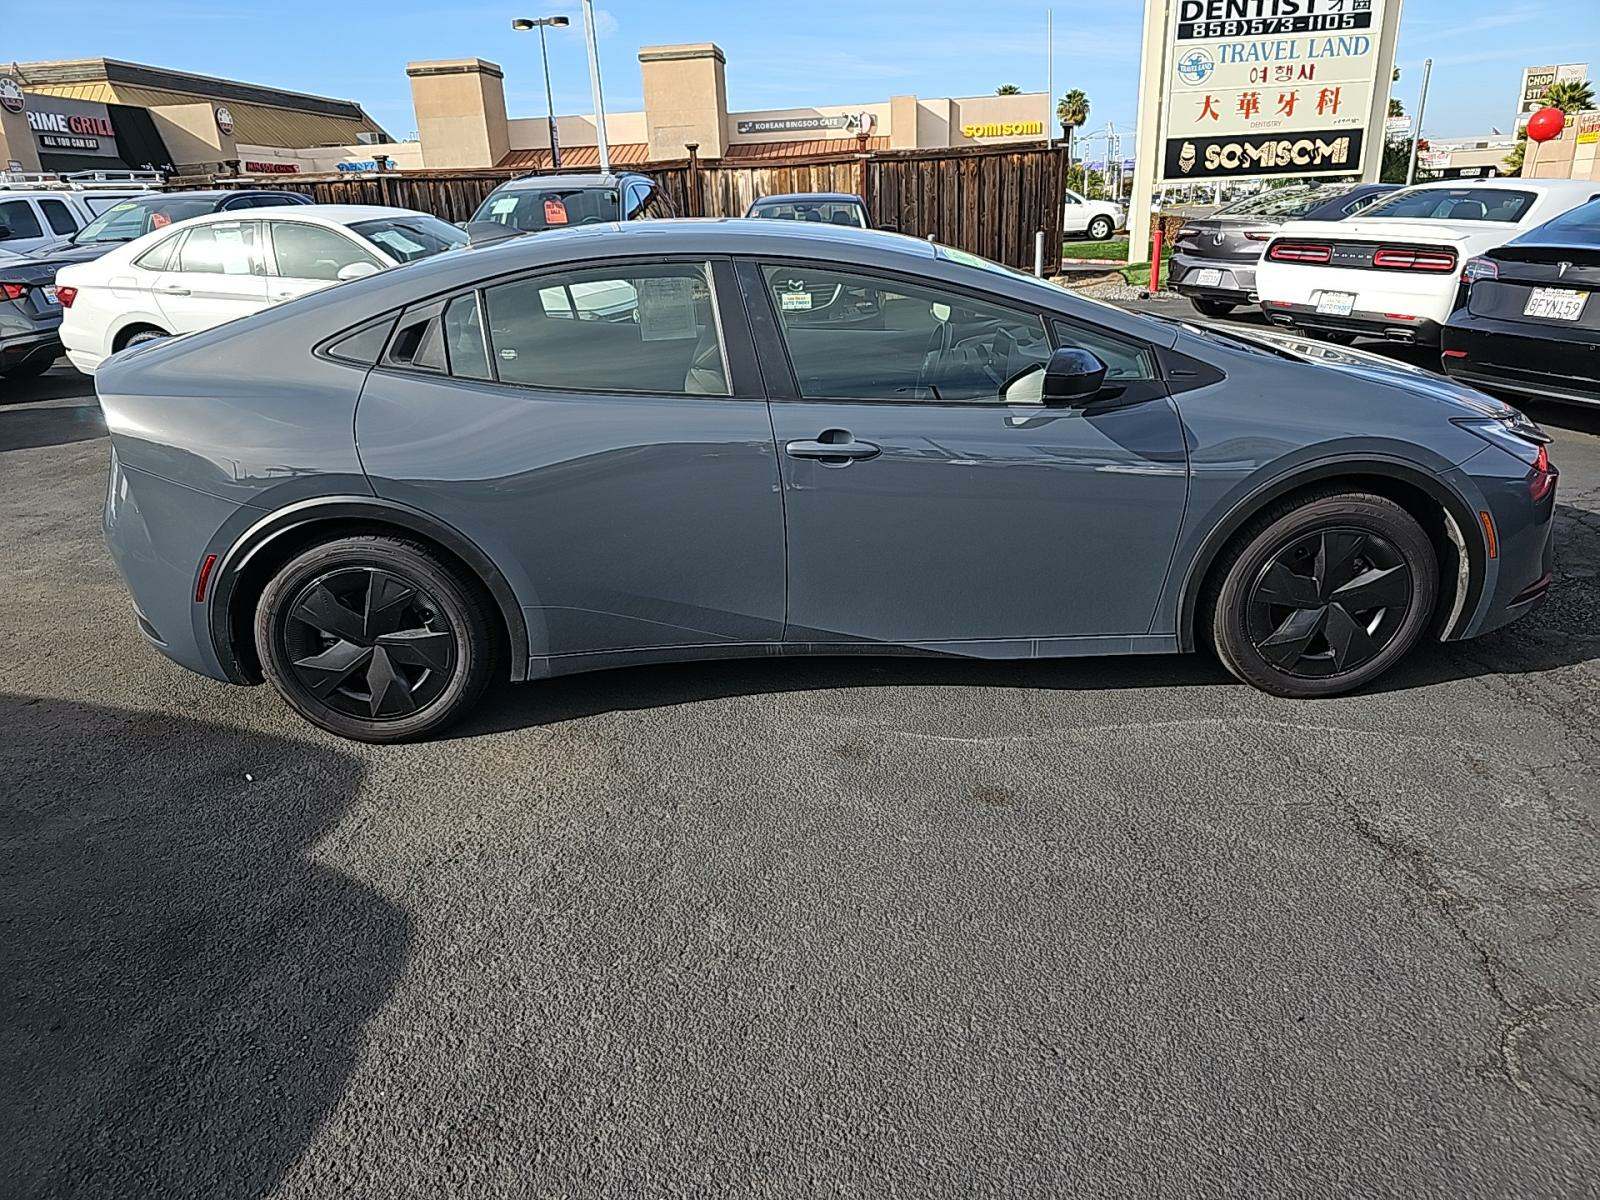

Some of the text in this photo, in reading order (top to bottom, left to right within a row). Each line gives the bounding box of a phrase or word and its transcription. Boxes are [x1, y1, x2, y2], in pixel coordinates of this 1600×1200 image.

[1192, 13, 1356, 38] 858)573-1105
[1218, 36, 1370, 64] TRAVEL LAND
[1527, 75, 1553, 87] CHOP
[26, 111, 115, 136] RIME GRILL
[755, 118, 838, 130] KOREAN BINGSOO CAFE
[1250, 120, 1283, 129] DENTISTRY
[44, 136, 97, 148] ALL YOU CAN EAT
[1204, 136, 1350, 170] SOMISOMI
